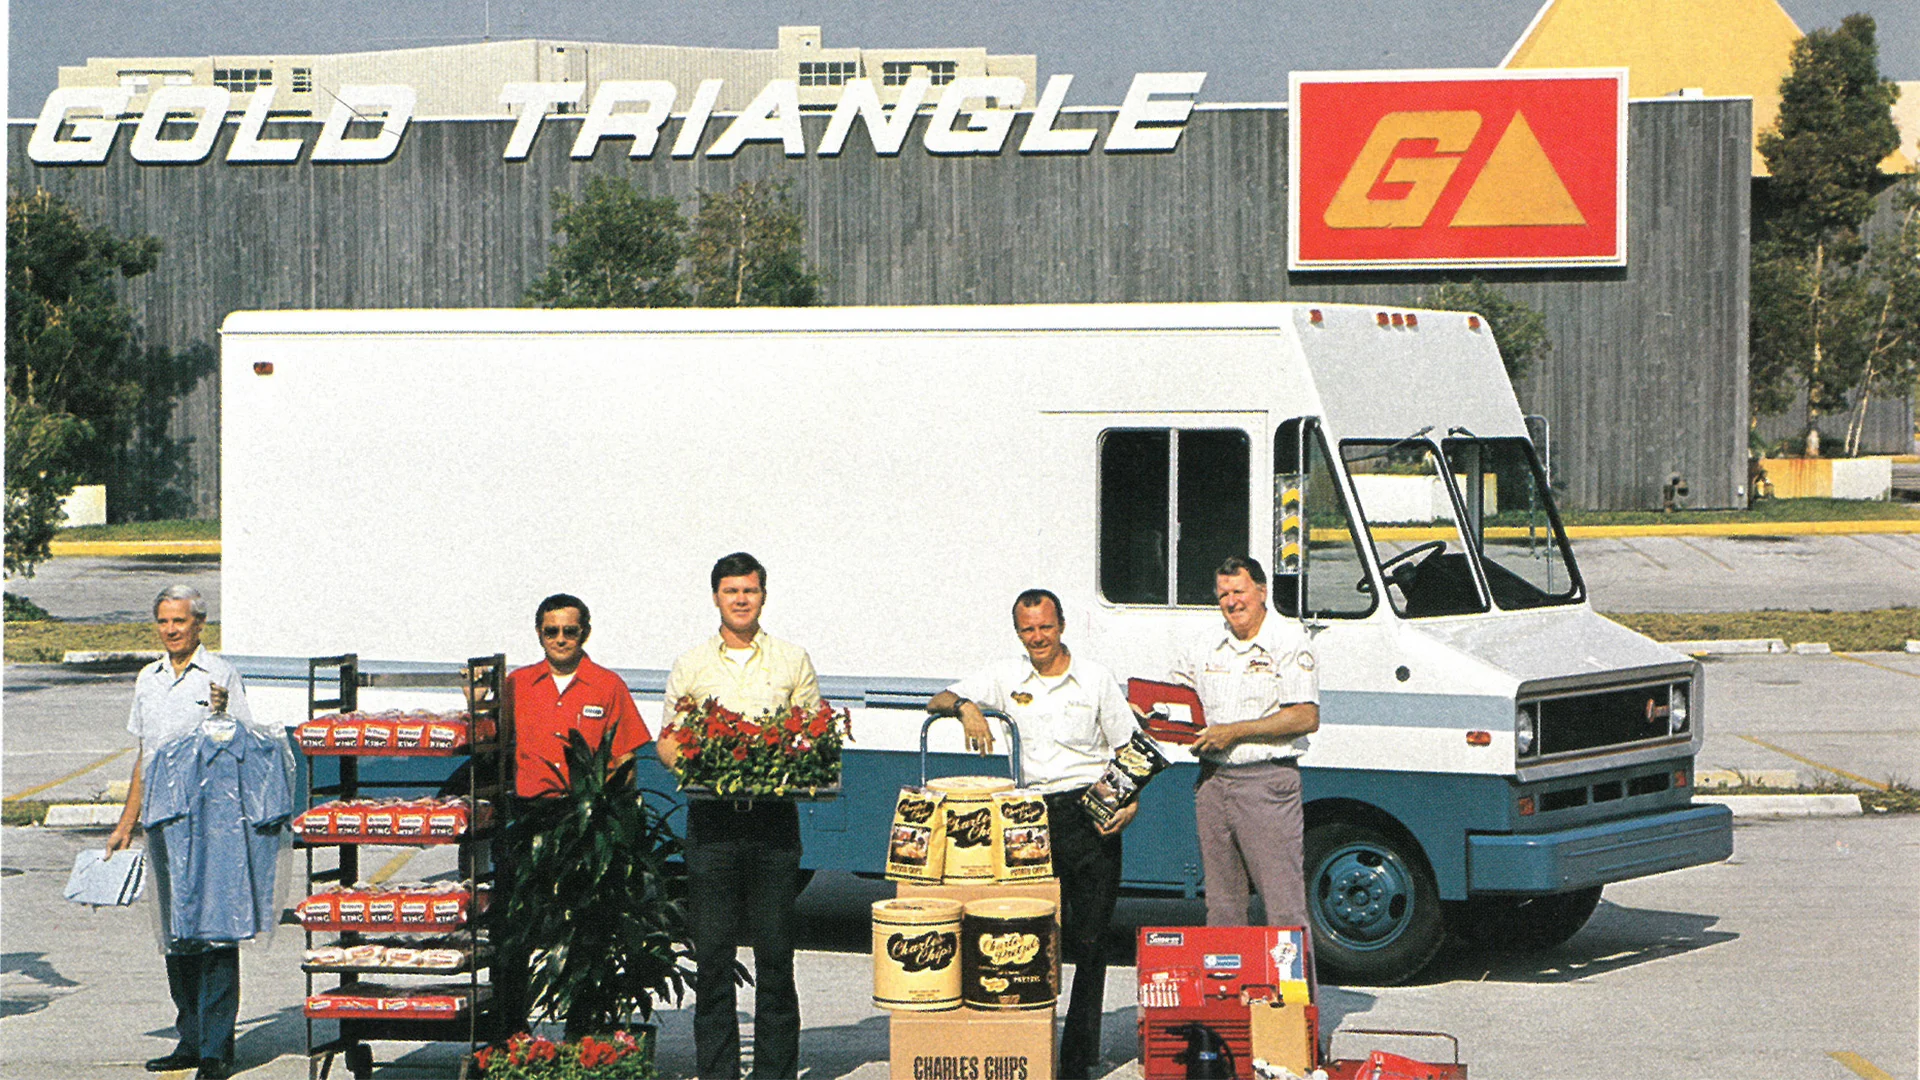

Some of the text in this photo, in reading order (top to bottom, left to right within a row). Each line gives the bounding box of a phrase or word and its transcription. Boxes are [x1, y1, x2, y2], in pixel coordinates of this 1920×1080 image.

[27, 72, 1208, 162] GOLD TRIANGLE
[913, 1056, 1028, 1080] CHARLES CHIPS
